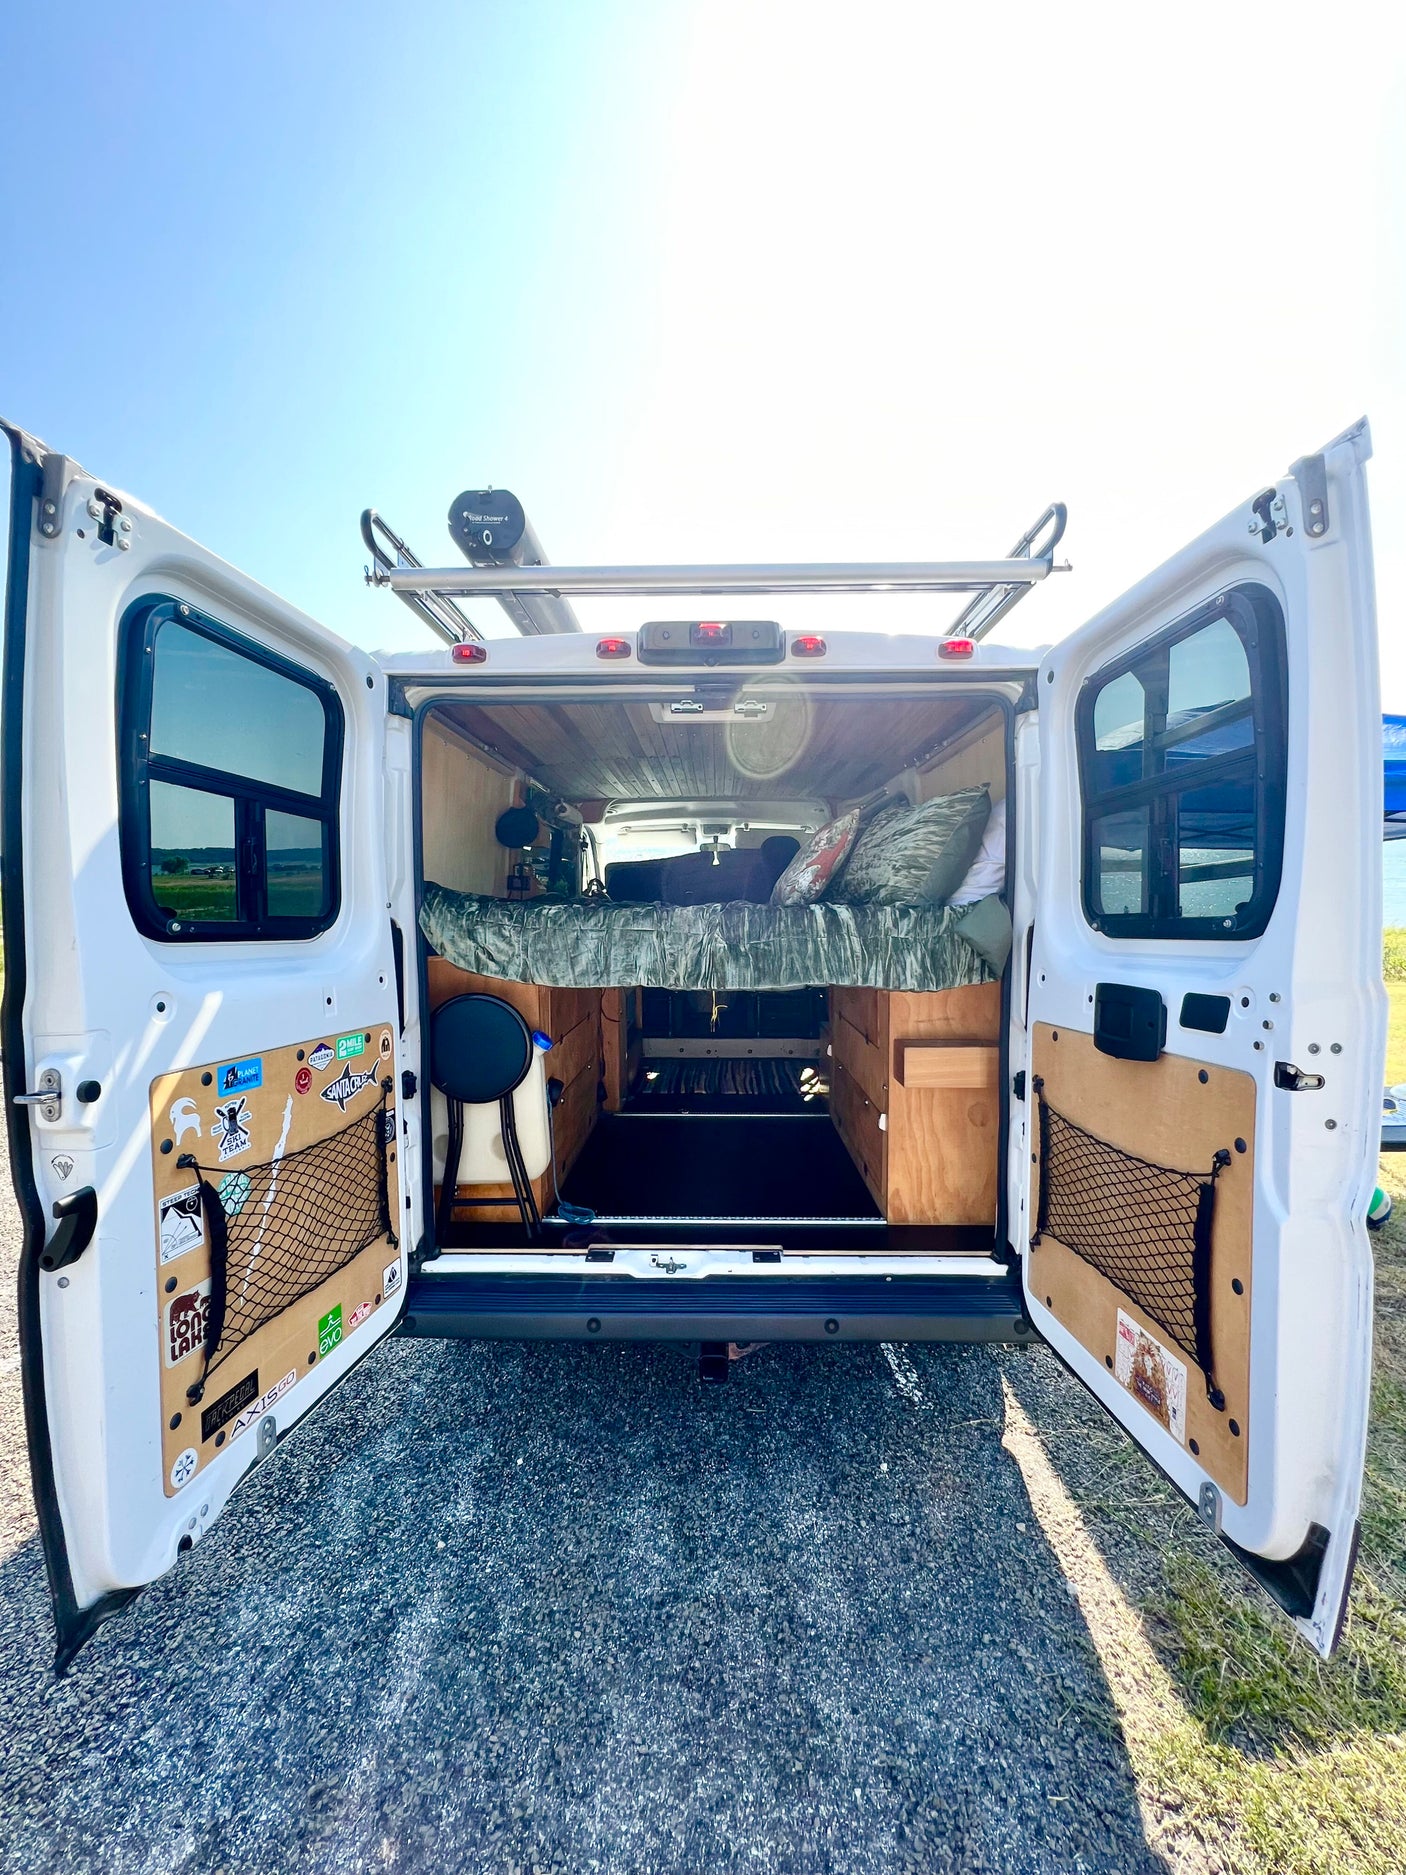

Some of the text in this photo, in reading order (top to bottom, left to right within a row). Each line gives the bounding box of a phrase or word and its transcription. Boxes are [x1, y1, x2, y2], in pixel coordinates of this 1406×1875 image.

[483, 514, 504, 522] Shower
[339, 1040, 347, 1057] 2
[347, 1036, 362, 1048] MILE
[238, 1066, 259, 1078] PLANET
[233, 1074, 259, 1087] GRANITE
[326, 1078, 350, 1099] SANTA
[223, 1139, 247, 1154] TEAM
[227, 1134, 241, 1146] SKI
[162, 1195, 182, 1208] STEEP
[320, 1327, 342, 1355] evo
